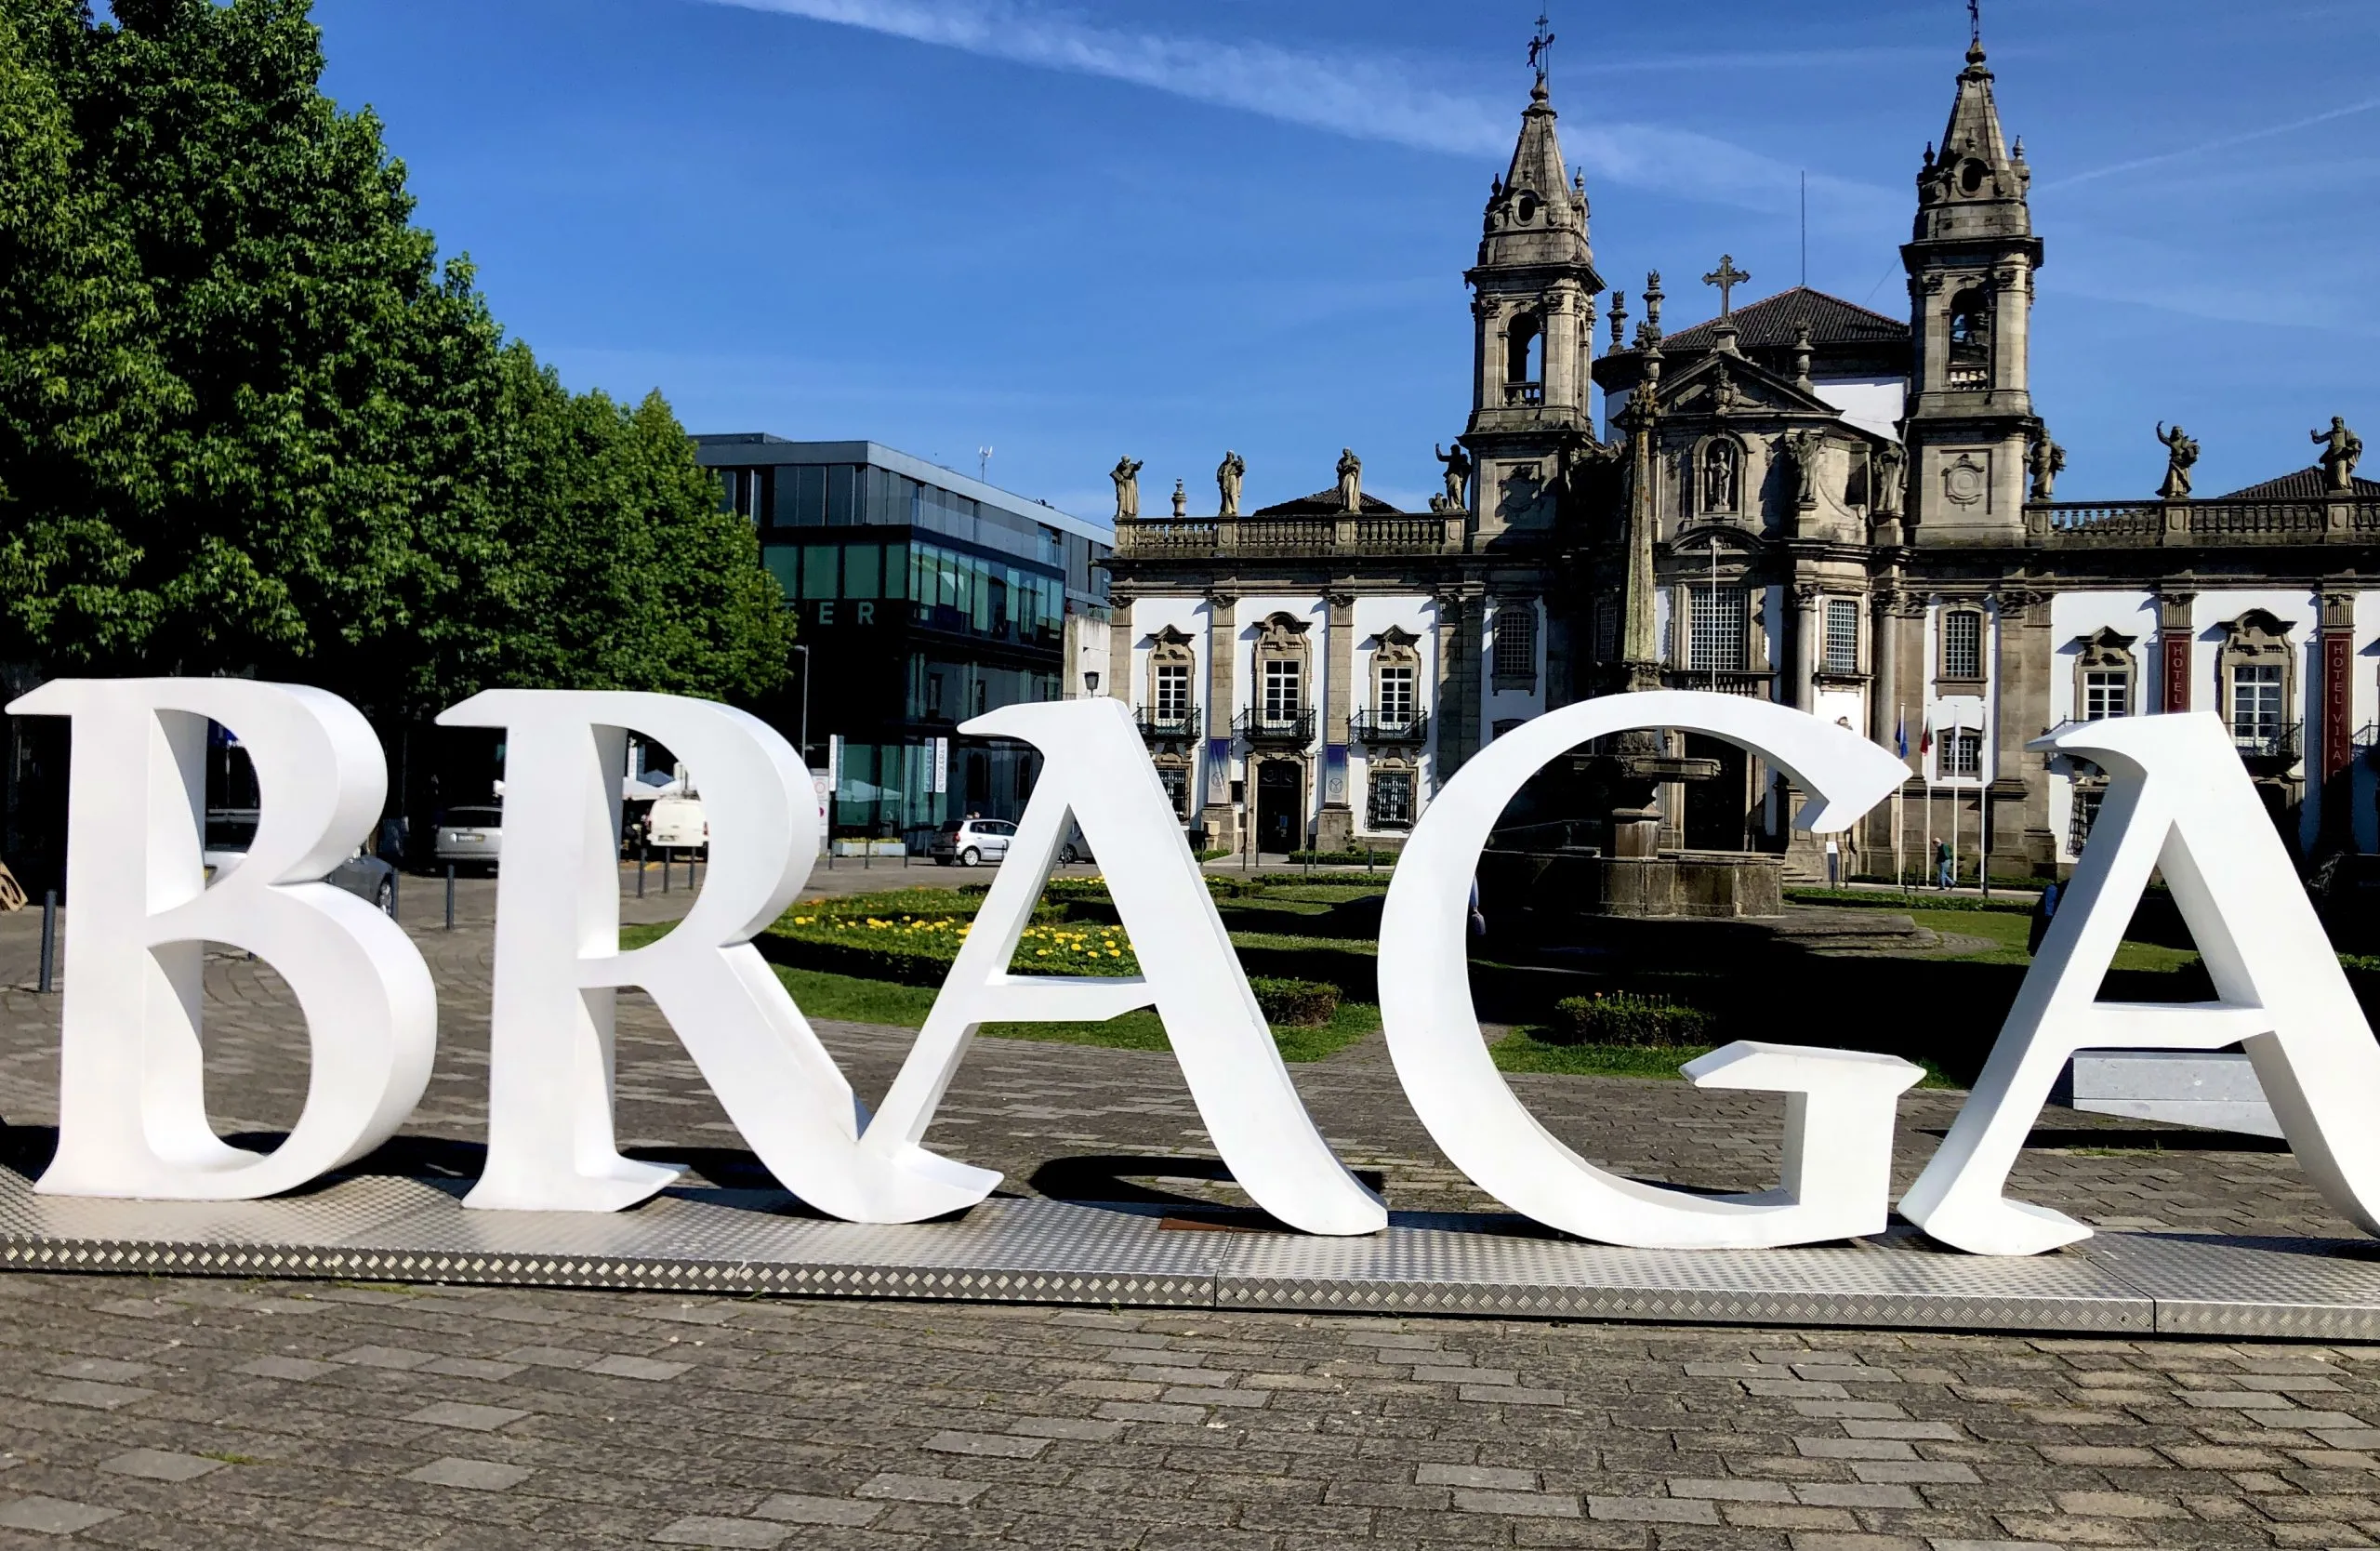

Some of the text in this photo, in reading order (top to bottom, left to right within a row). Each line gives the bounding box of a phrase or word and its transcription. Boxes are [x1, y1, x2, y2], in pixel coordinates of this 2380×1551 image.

[2173, 645, 2183, 704] HOTEL
[2333, 644, 2343, 705] HOTEL
[2333, 713, 2343, 761] VILA
[5, 677, 2380, 1258] BRAGA
